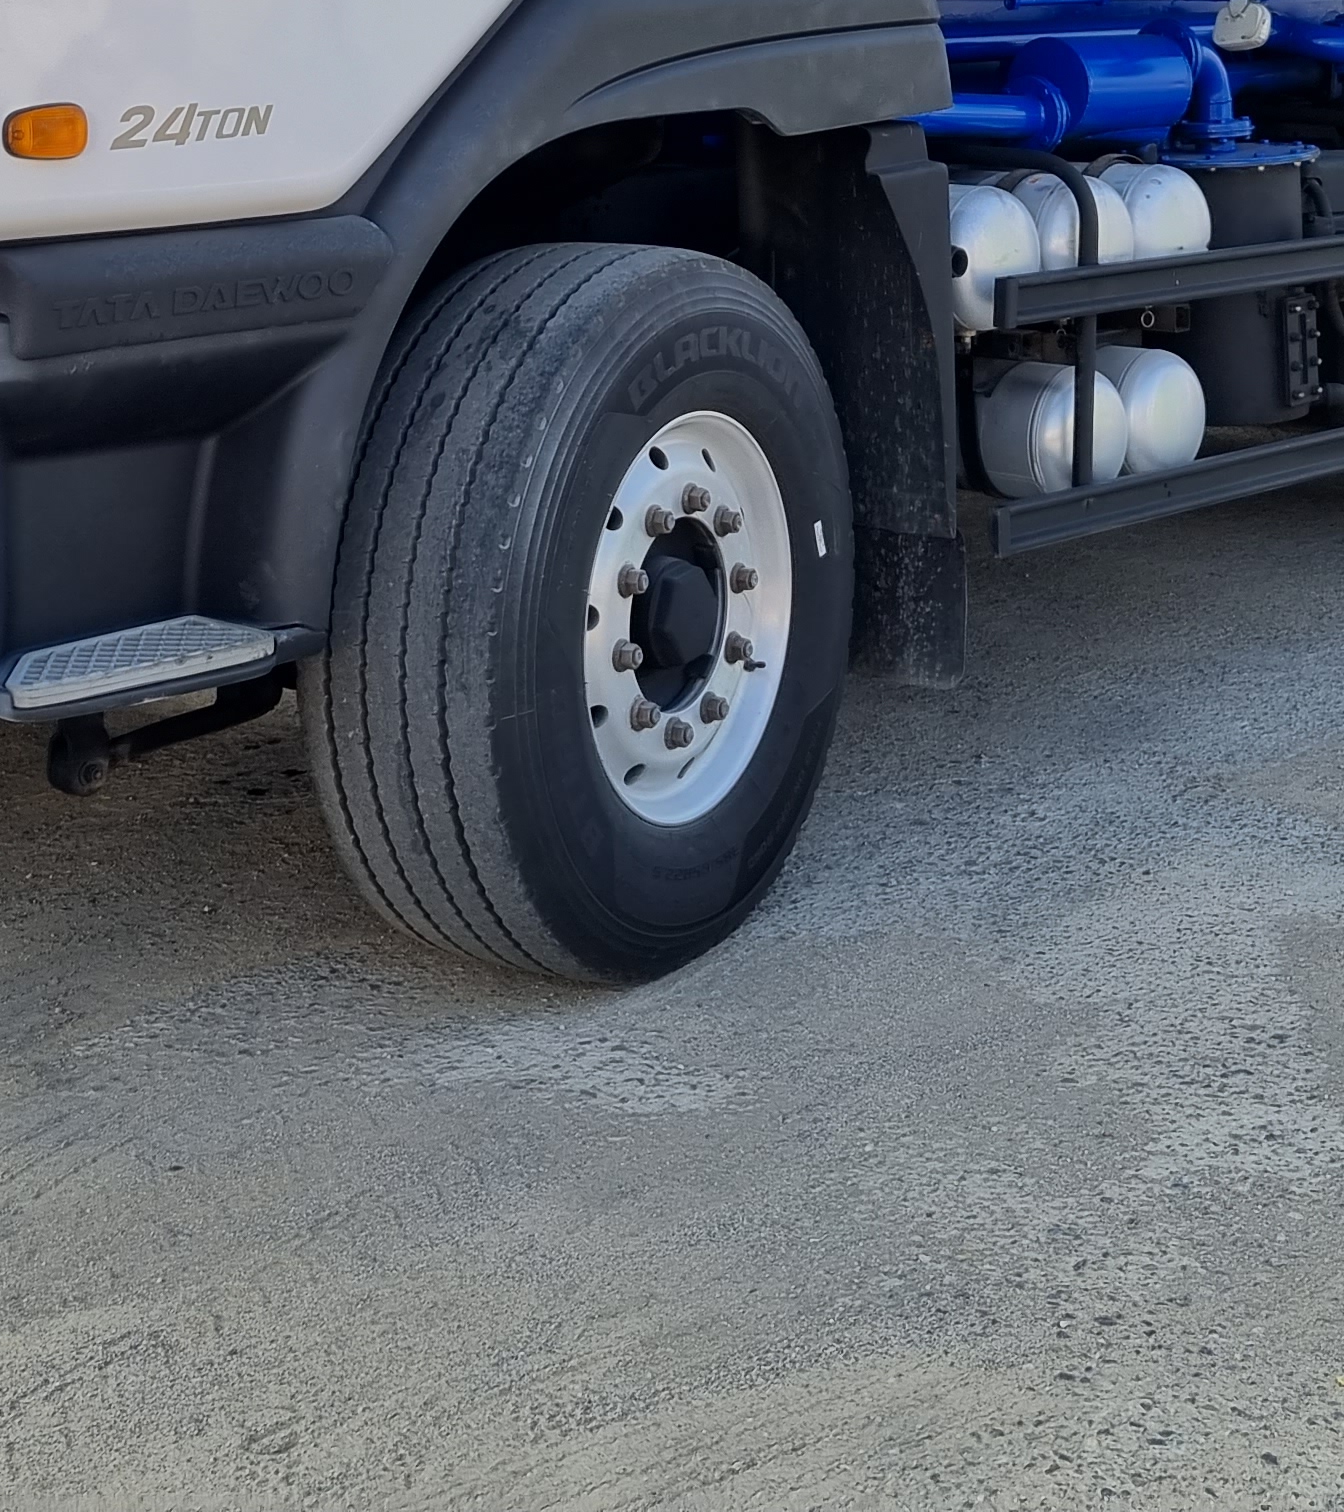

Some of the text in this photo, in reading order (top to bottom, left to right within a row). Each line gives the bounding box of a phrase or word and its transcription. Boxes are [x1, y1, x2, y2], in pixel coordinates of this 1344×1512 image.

[53, 267, 356, 330] TATA DAEWOO
[627, 326, 805, 412] BLACKLION
